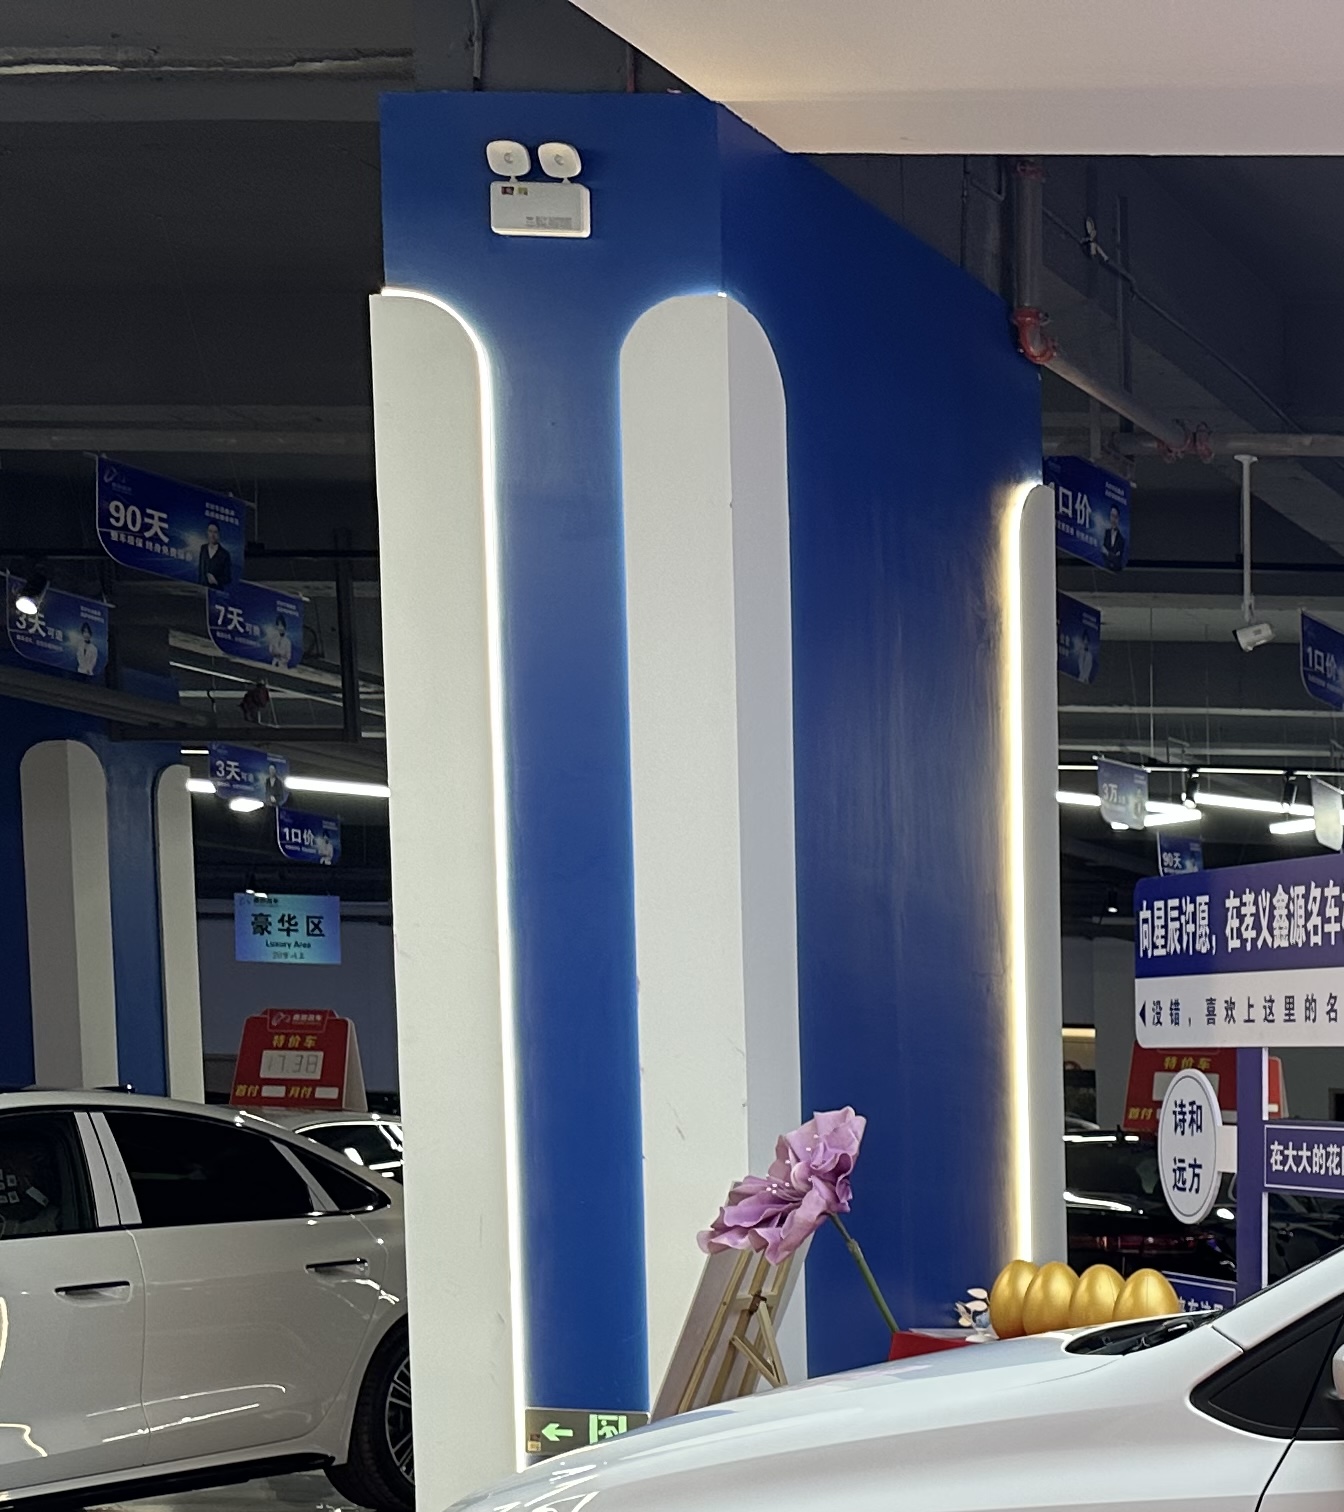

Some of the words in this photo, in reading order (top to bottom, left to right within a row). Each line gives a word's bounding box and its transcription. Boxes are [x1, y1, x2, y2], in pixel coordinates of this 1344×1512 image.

[109, 501, 169, 543] 90天
[284, 827, 315, 847] 1口价
[251, 913, 325, 937] 豪华区
[272, 1034, 318, 1049] 特价车
[1172, 1100, 1203, 1136] 诗和
[1172, 1156, 1203, 1194] 远方
